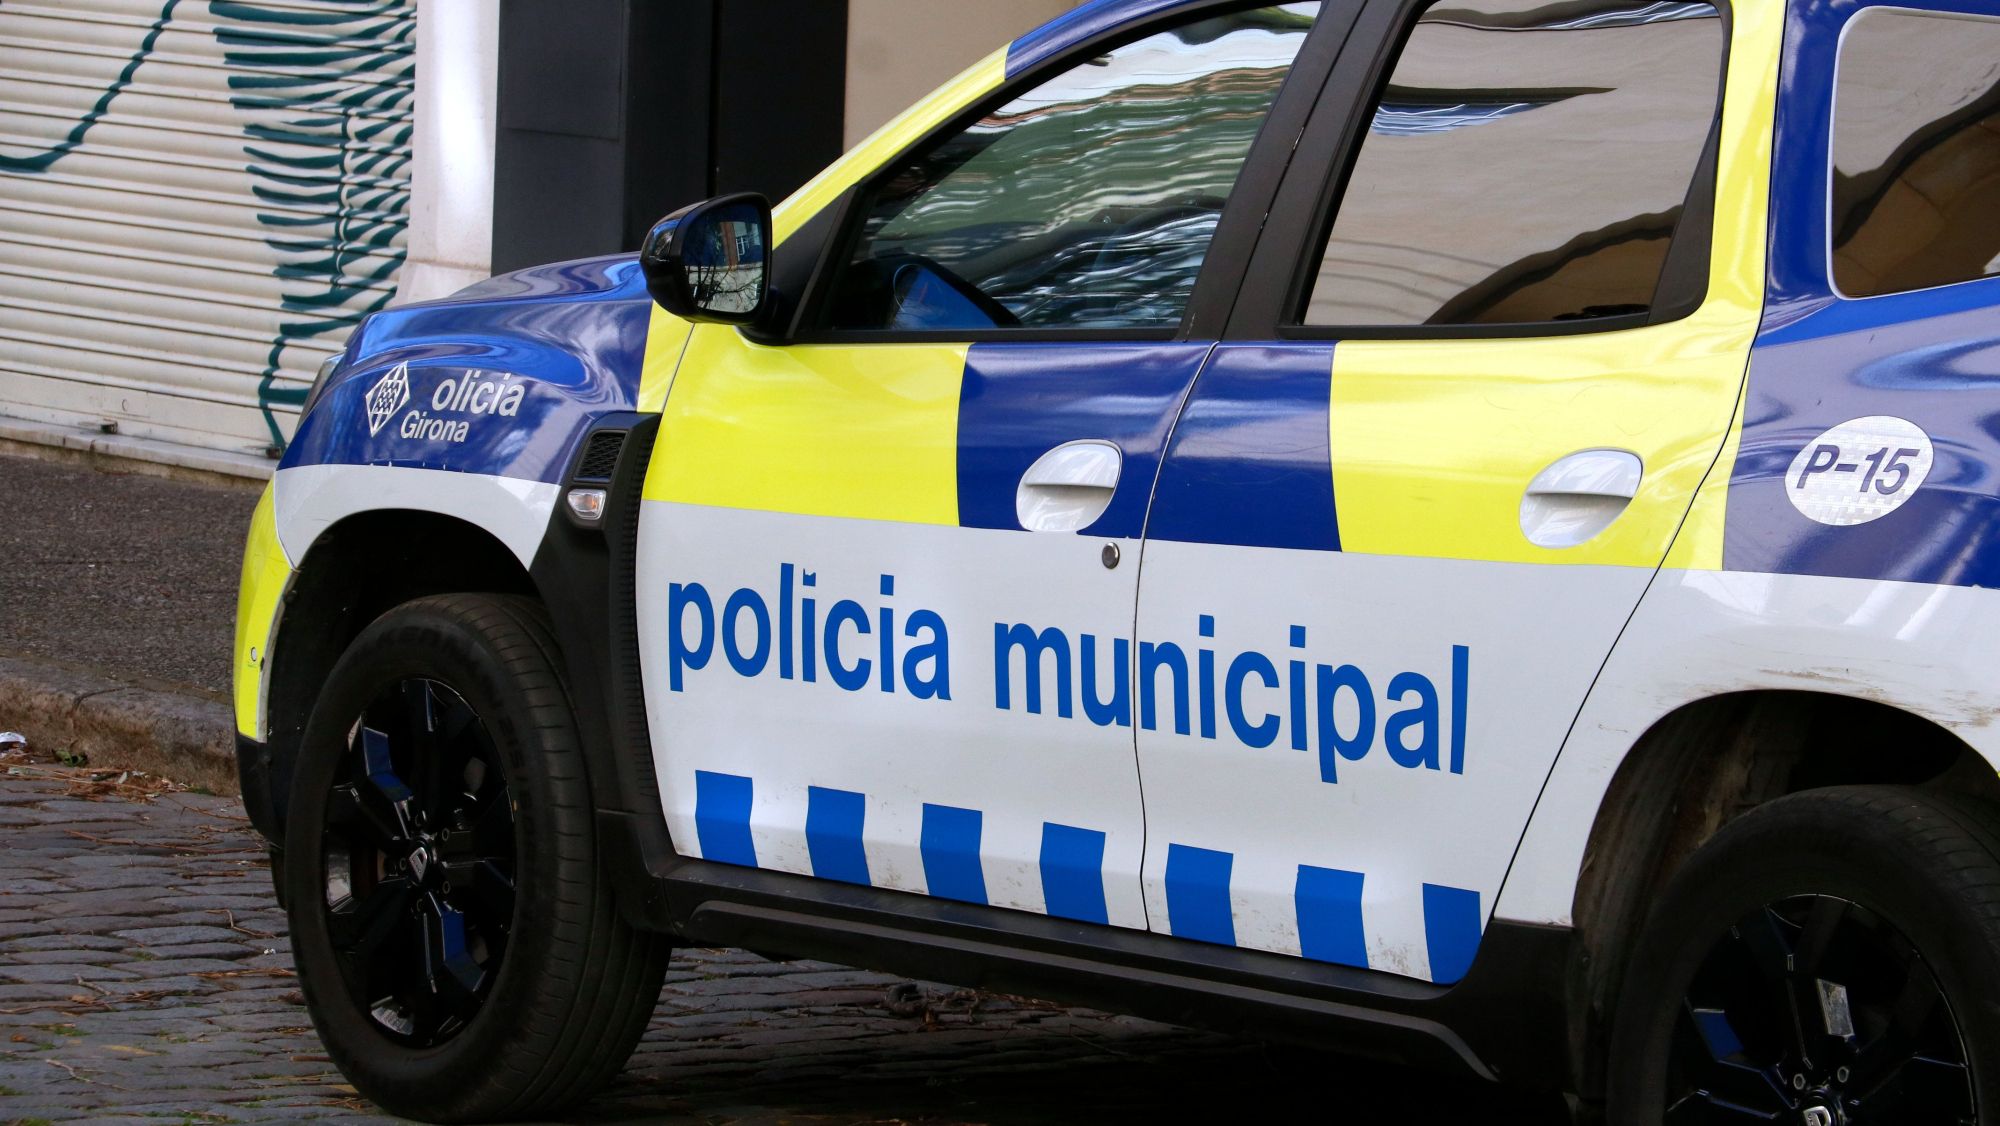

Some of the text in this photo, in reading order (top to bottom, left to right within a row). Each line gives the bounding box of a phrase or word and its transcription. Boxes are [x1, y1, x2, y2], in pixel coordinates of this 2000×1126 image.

[400, 410, 470, 442] Girona
[1796, 445, 1920, 495] P-15
[669, 563, 951, 700] policia
[995, 615, 1469, 784] municipal
